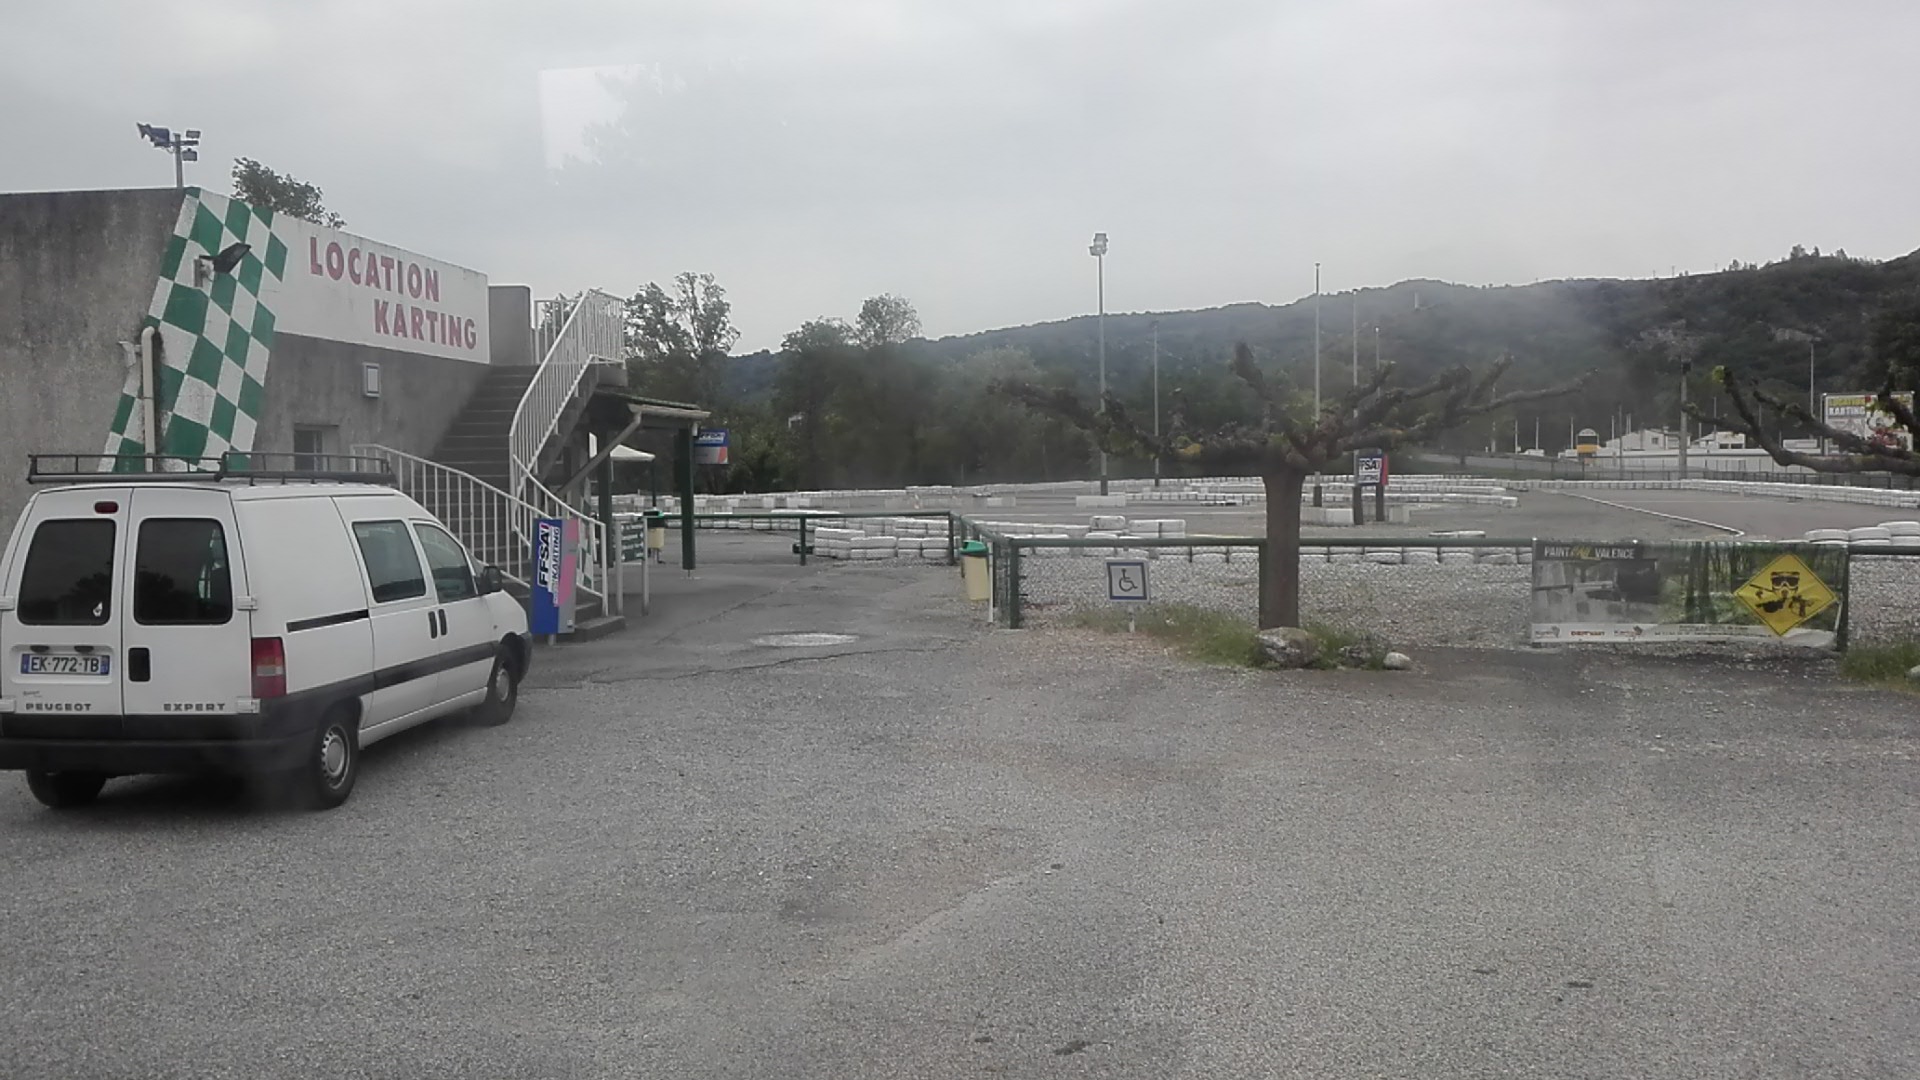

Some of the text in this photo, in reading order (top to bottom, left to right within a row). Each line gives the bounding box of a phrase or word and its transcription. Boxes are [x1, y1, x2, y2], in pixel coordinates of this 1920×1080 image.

[310, 237, 440, 302] LOCATION
[374, 299, 477, 350] KARTING
[539, 528, 550, 586] FFSA
[552, 527, 560, 579] KARTING
[1544, 546, 1571, 557] PAINT
[1594, 548, 1636, 559] VALENCE
[31, 656, 99, 673] EK-772-TB
[25, 702, 92, 712] PEUGEOT
[163, 703, 226, 712] EXPERT
